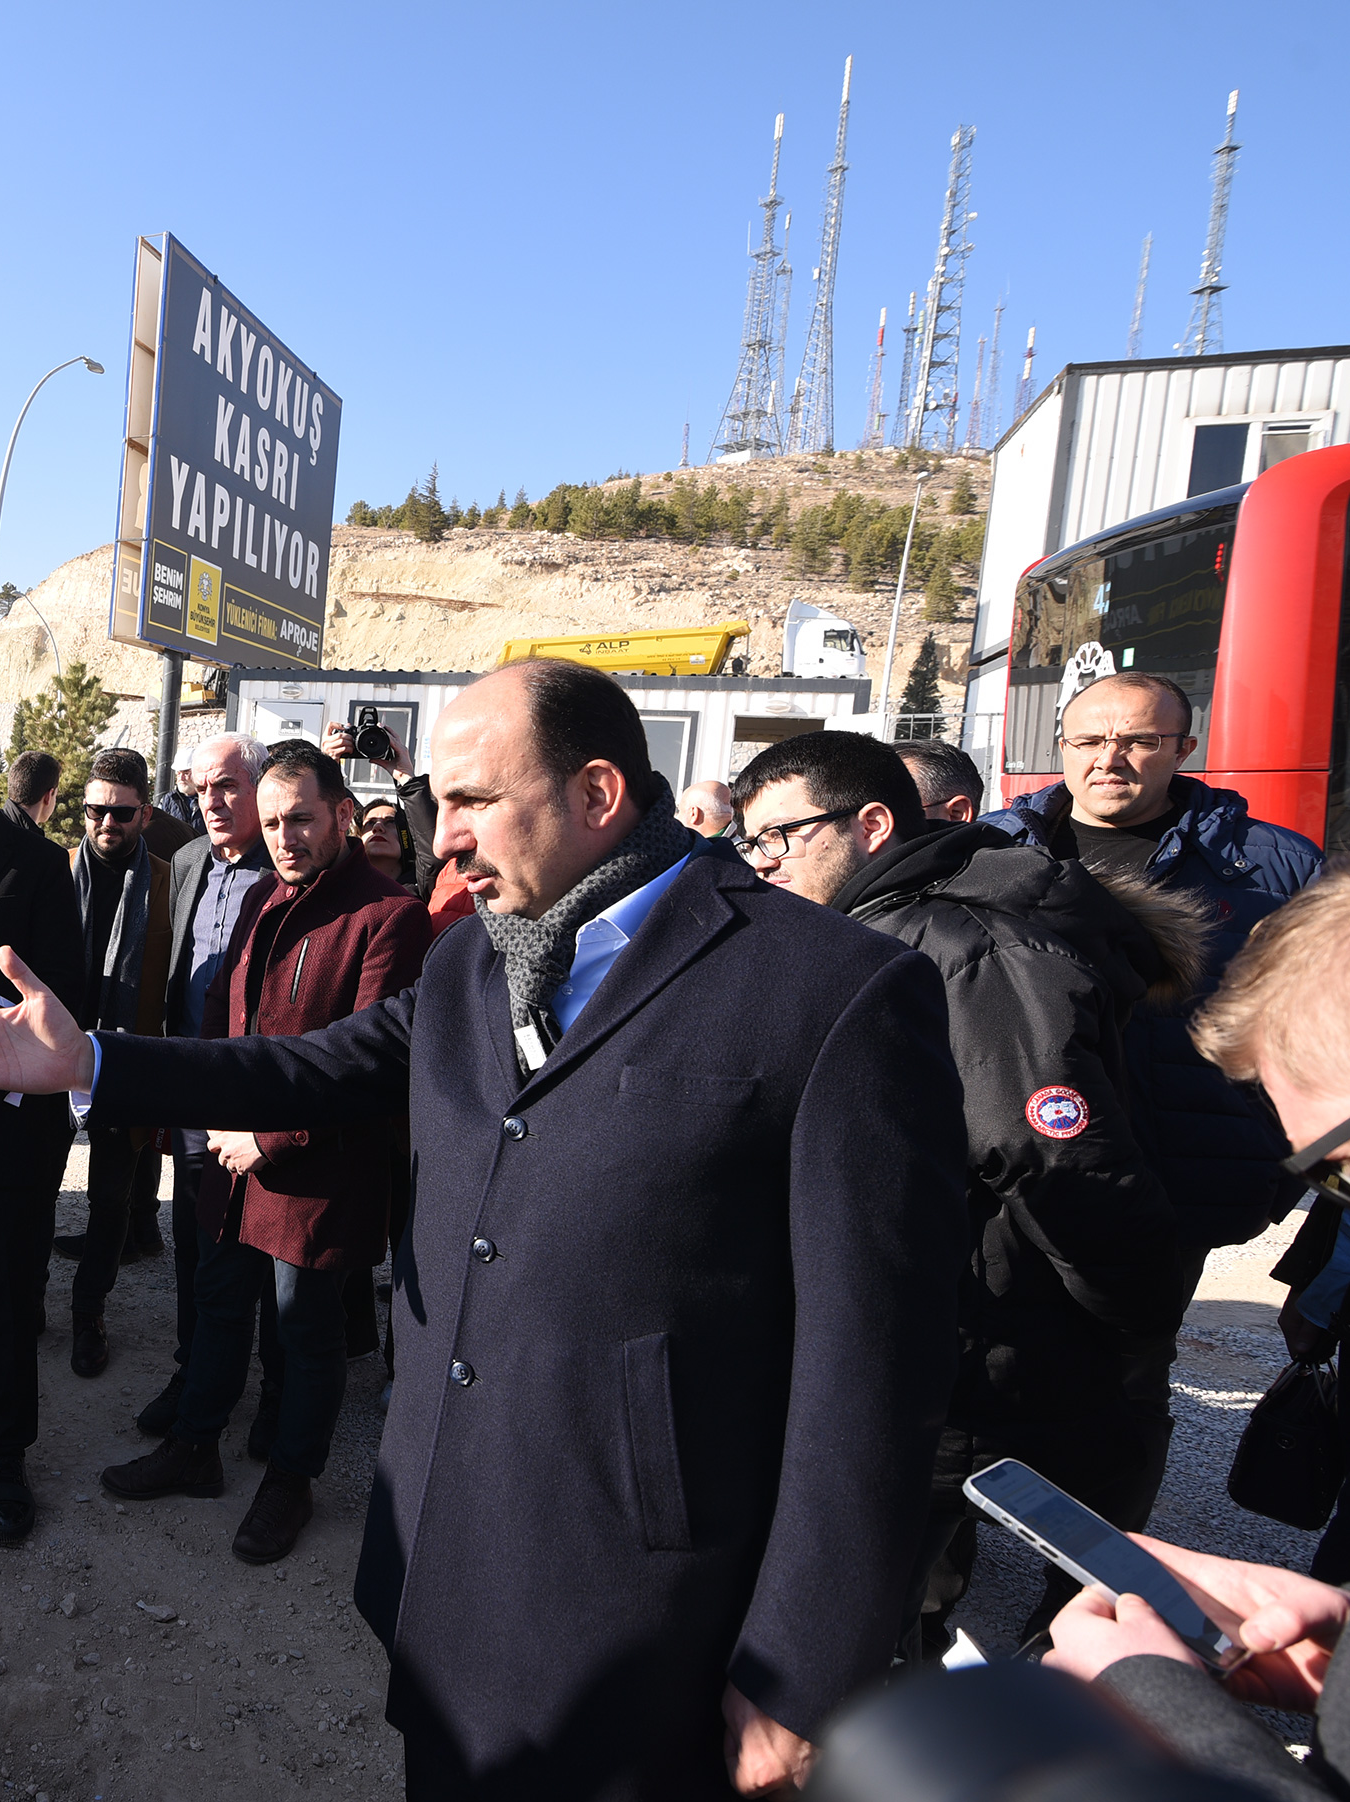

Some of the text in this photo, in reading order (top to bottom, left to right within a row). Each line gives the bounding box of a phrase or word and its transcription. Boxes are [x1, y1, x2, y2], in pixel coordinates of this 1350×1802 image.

[191, 286, 324, 467] AKYOKUŞ
[213, 393, 300, 512] KASRI
[169, 454, 320, 600] YAPILIYOR
[280, 619, 319, 653] APROJE
[596, 641, 630, 650] ALP
[401, 829, 409, 849] Nikon
[1031, 1089, 1053, 1105] CANADA
[1037, 1125, 1060, 1137] ARCTIC
